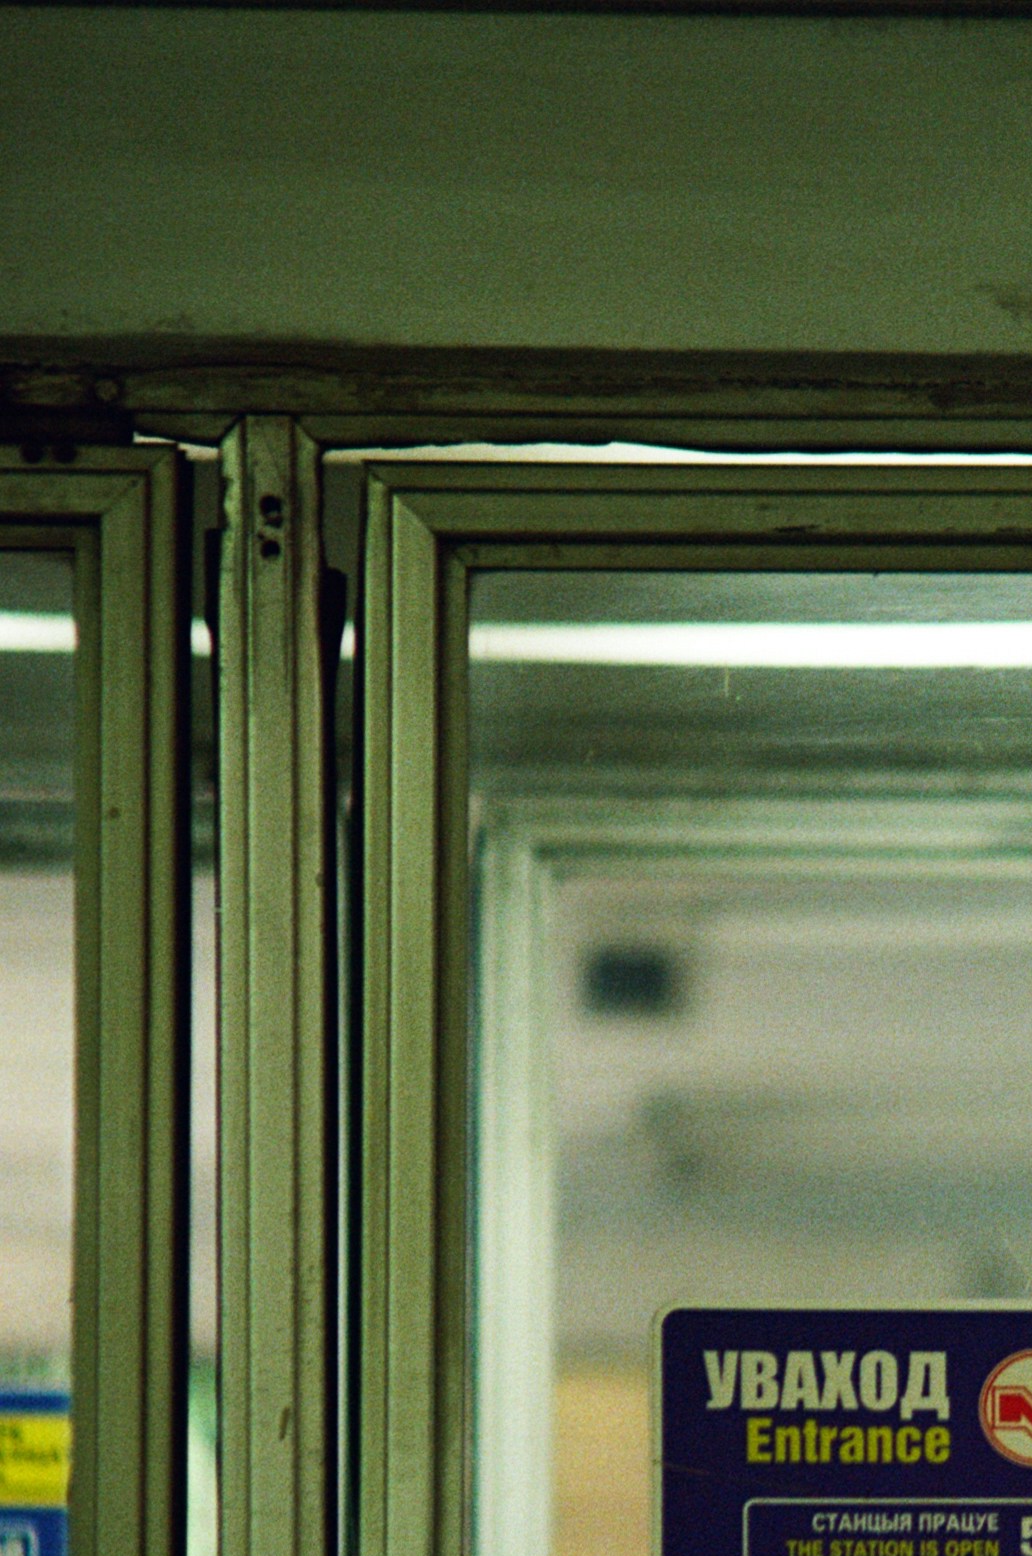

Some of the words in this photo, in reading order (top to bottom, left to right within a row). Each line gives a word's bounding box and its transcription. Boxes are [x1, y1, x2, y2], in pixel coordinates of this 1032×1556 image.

[703, 1350, 951, 1421] УВАХОД
[746, 1417, 951, 1464] Entrance
[811, 1512, 913, 1534] СТАНЦЫЯ
[918, 1512, 999, 1534] ПРАЦУЕ
